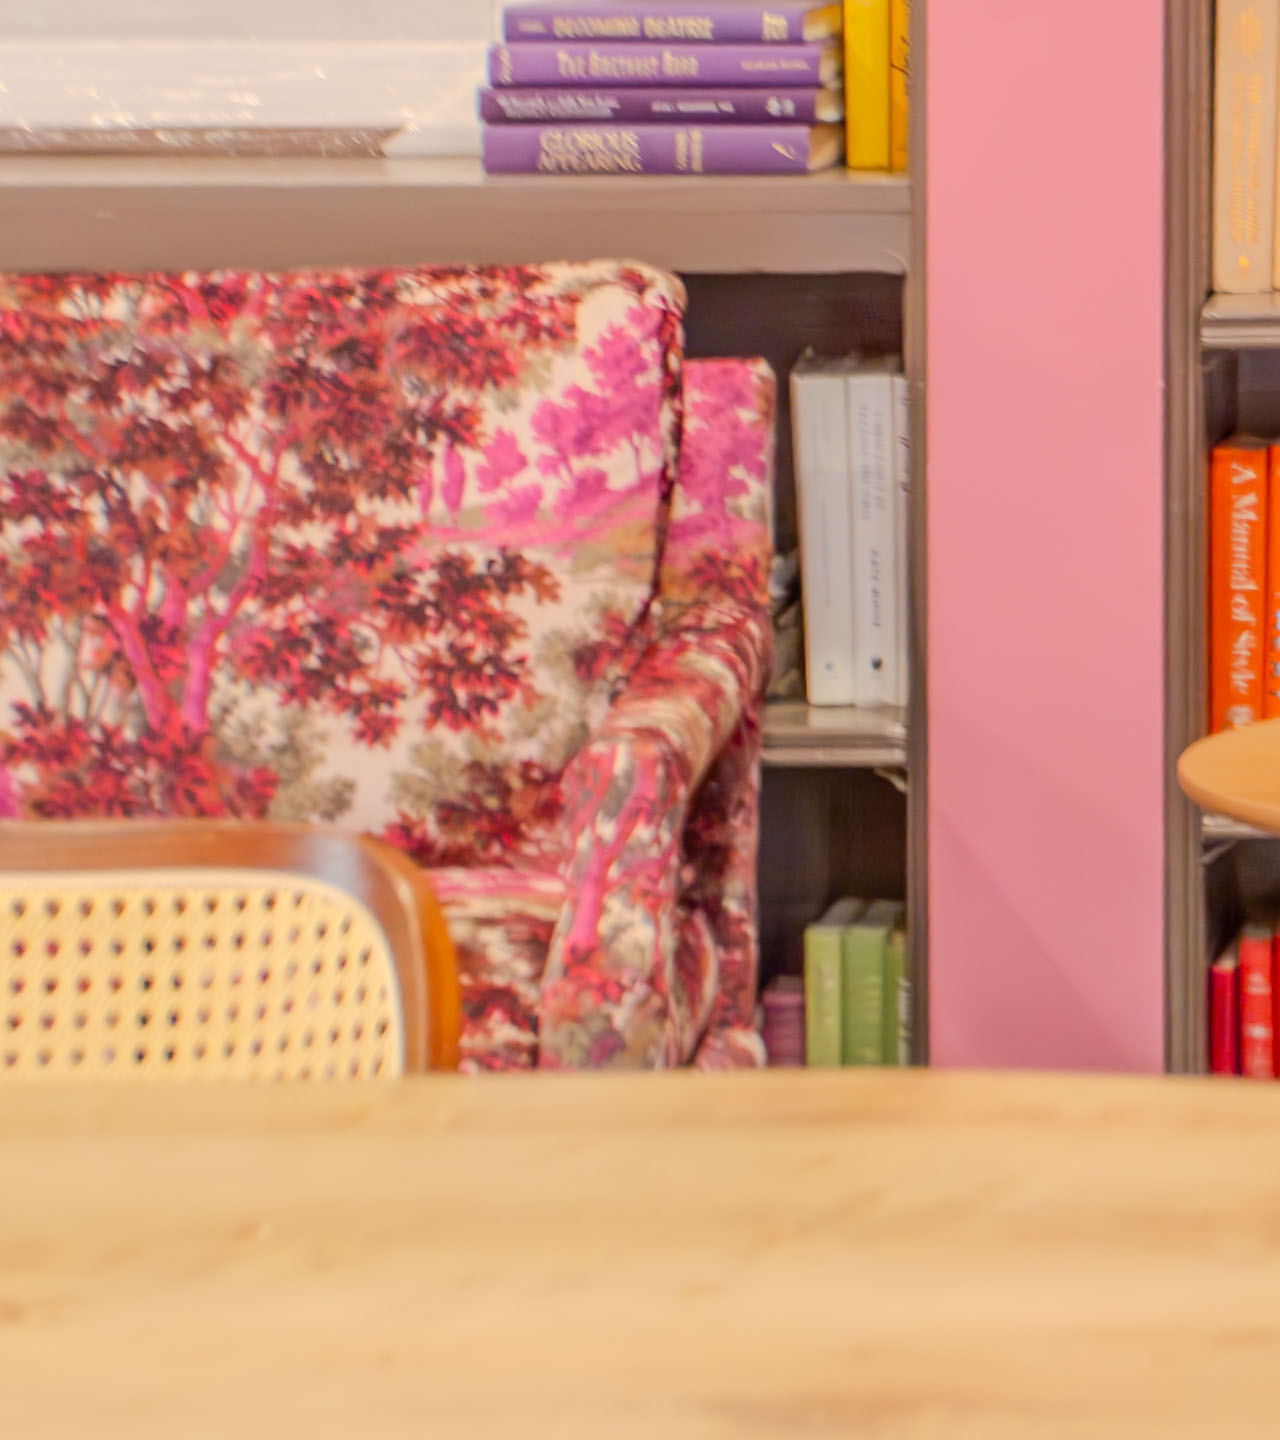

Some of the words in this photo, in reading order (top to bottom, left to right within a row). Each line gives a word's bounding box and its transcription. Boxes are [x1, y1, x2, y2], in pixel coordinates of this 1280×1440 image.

[1230, 461, 1257, 484] A
[1230, 492, 1259, 592] Manual
[1230, 593, 1257, 625] of
[1230, 629, 1257, 694] Style
